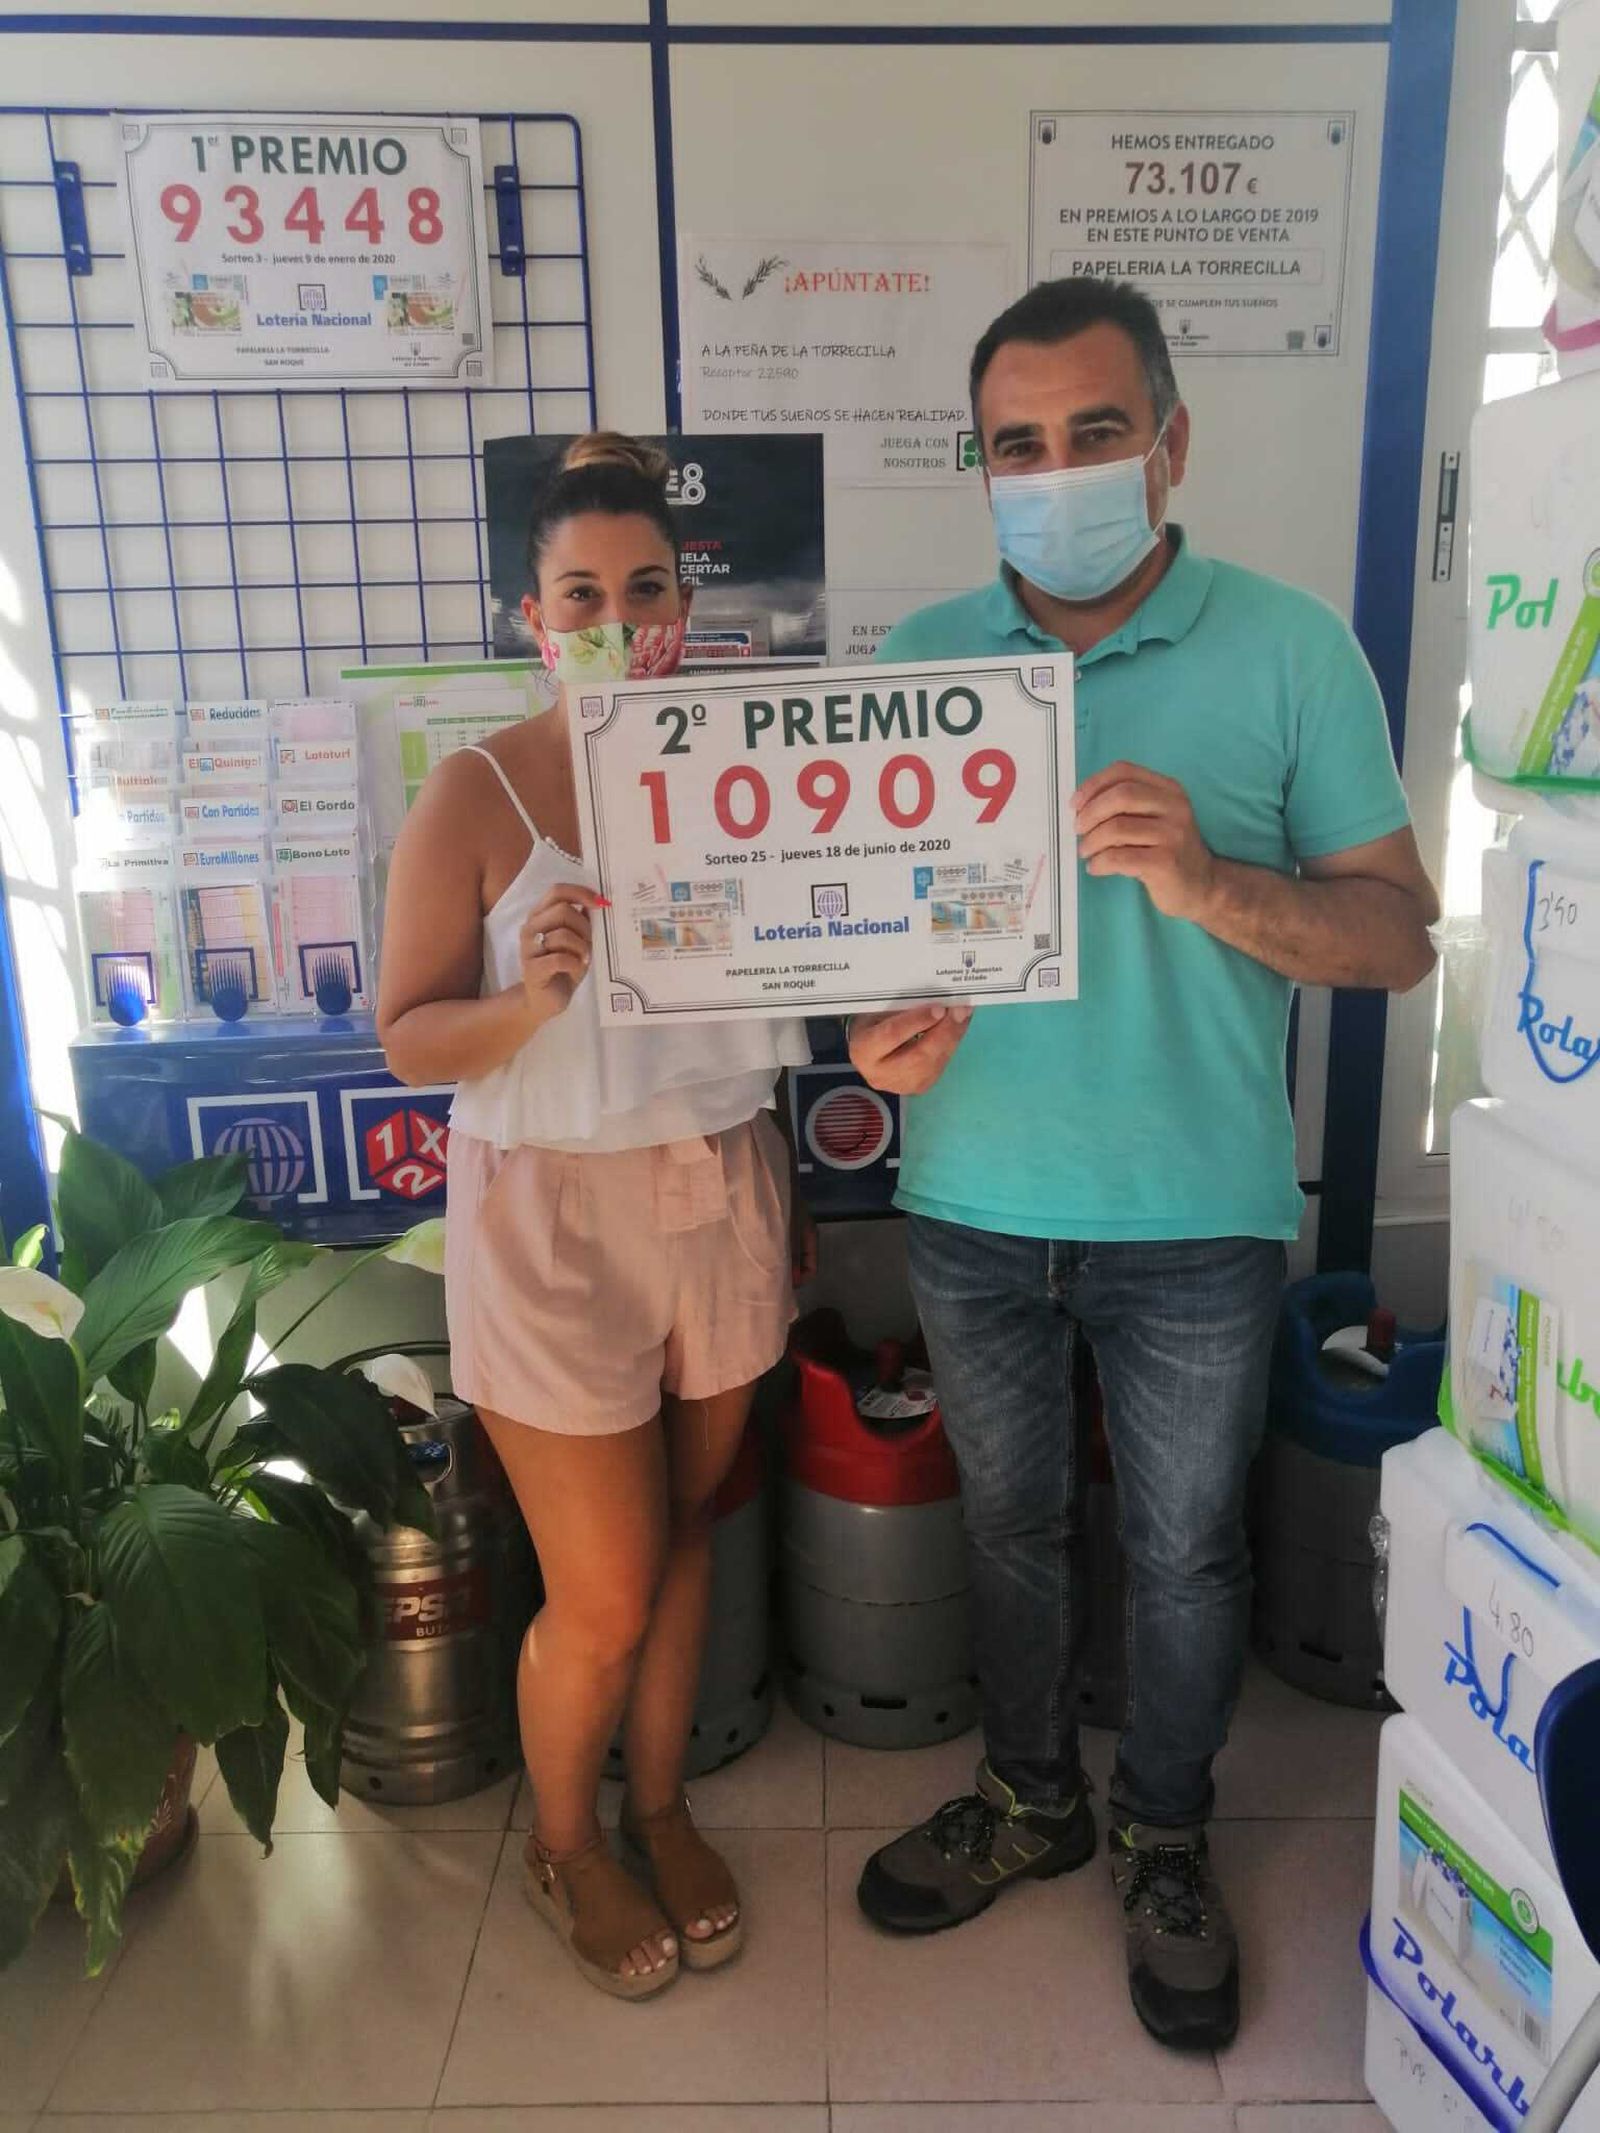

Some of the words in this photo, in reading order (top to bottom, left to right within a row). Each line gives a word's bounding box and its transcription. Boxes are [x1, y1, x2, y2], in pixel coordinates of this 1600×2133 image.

[1111, 134, 1171, 151] HEMOS
[1174, 134, 1275, 151] ENTREGADO
[231, 135, 407, 176] PREMIO
[1125, 161, 1242, 195] 73.107
[1246, 177, 1259, 195] €
[1059, 208, 1081, 224] EN
[1086, 208, 1158, 223] PREMIOS
[1161, 208, 1173, 223] A
[1176, 208, 1197, 223] LO
[1202, 208, 1256, 223] LARGO
[1260, 208, 1281, 223] DE
[1285, 208, 1319, 223] 2019
[1087, 227, 1109, 243] EN
[1113, 227, 1150, 243] ESTE
[1153, 227, 1209, 243] PUNTO
[1213, 227, 1234, 243] DE
[1238, 227, 1290, 243] VENTA
[221, 254, 253, 264] Sorteo
[255, 254, 262, 264] 3
[273, 254, 303, 266] jueves
[305, 254, 312, 264] 9
[314, 253, 326, 264] de
[328, 255, 356, 264] enero
[358, 254, 370, 264] de
[372, 254, 396, 264] 2020
[1072, 260, 1166, 276] PAPELERIA
[1170, 260, 1192, 276] LA
[1198, 260, 1301, 275] TORRECILLA
[784, 267, 930, 294] ¡APÚNTATE!
[311, 312, 372, 327] Nacional
[701, 345, 712, 358] A
[714, 345, 731, 358] LA
[734, 343, 769, 358] PEÑA
[771, 345, 789, 358] DE
[791, 345, 808, 358] LA
[811, 345, 896, 358] TORRECILLA
[702, 409, 748, 422] DONDE
[751, 409, 777, 422] TUS
[781, 408, 831, 422] SUEÑOS
[834, 409, 850, 422] SE
[853, 409, 895, 422] HACEN
[881, 437, 921, 449] JUEGA
[924, 437, 949, 449] CON
[883, 456, 946, 469] NOSOTROS
[681, 552, 711, 562] IELA
[679, 564, 731, 574] CERTAR
[852, 625, 868, 636] EN
[844, 644, 877, 655] JUGA
[743, 686, 984, 750] PREMIO
[299, 800, 312, 812] El
[316, 799, 356, 811] Gordo
[200, 851, 260, 866] EuroMillones
[704, 853, 748, 866] Sorteo
[750, 851, 767, 863] 25
[781, 848, 823, 864] jueves
[826, 845, 842, 858] 18
[844, 844, 861, 857] de
[863, 842, 896, 858] junio
[899, 840, 916, 853] de
[918, 838, 951, 852] 2020
[754, 921, 822, 942] Lotería
[828, 916, 910, 938] Nacional
[725, 966, 776, 978] PAPELERIA
[778, 965, 790, 975] LA
[792, 962, 851, 974] TORRECILLA
[762, 981, 781, 991] SAN
[783, 979, 817, 990] ROQUE
[1516, 991, 1600, 1061] Pola
[376, 1122, 394, 1161] 1
